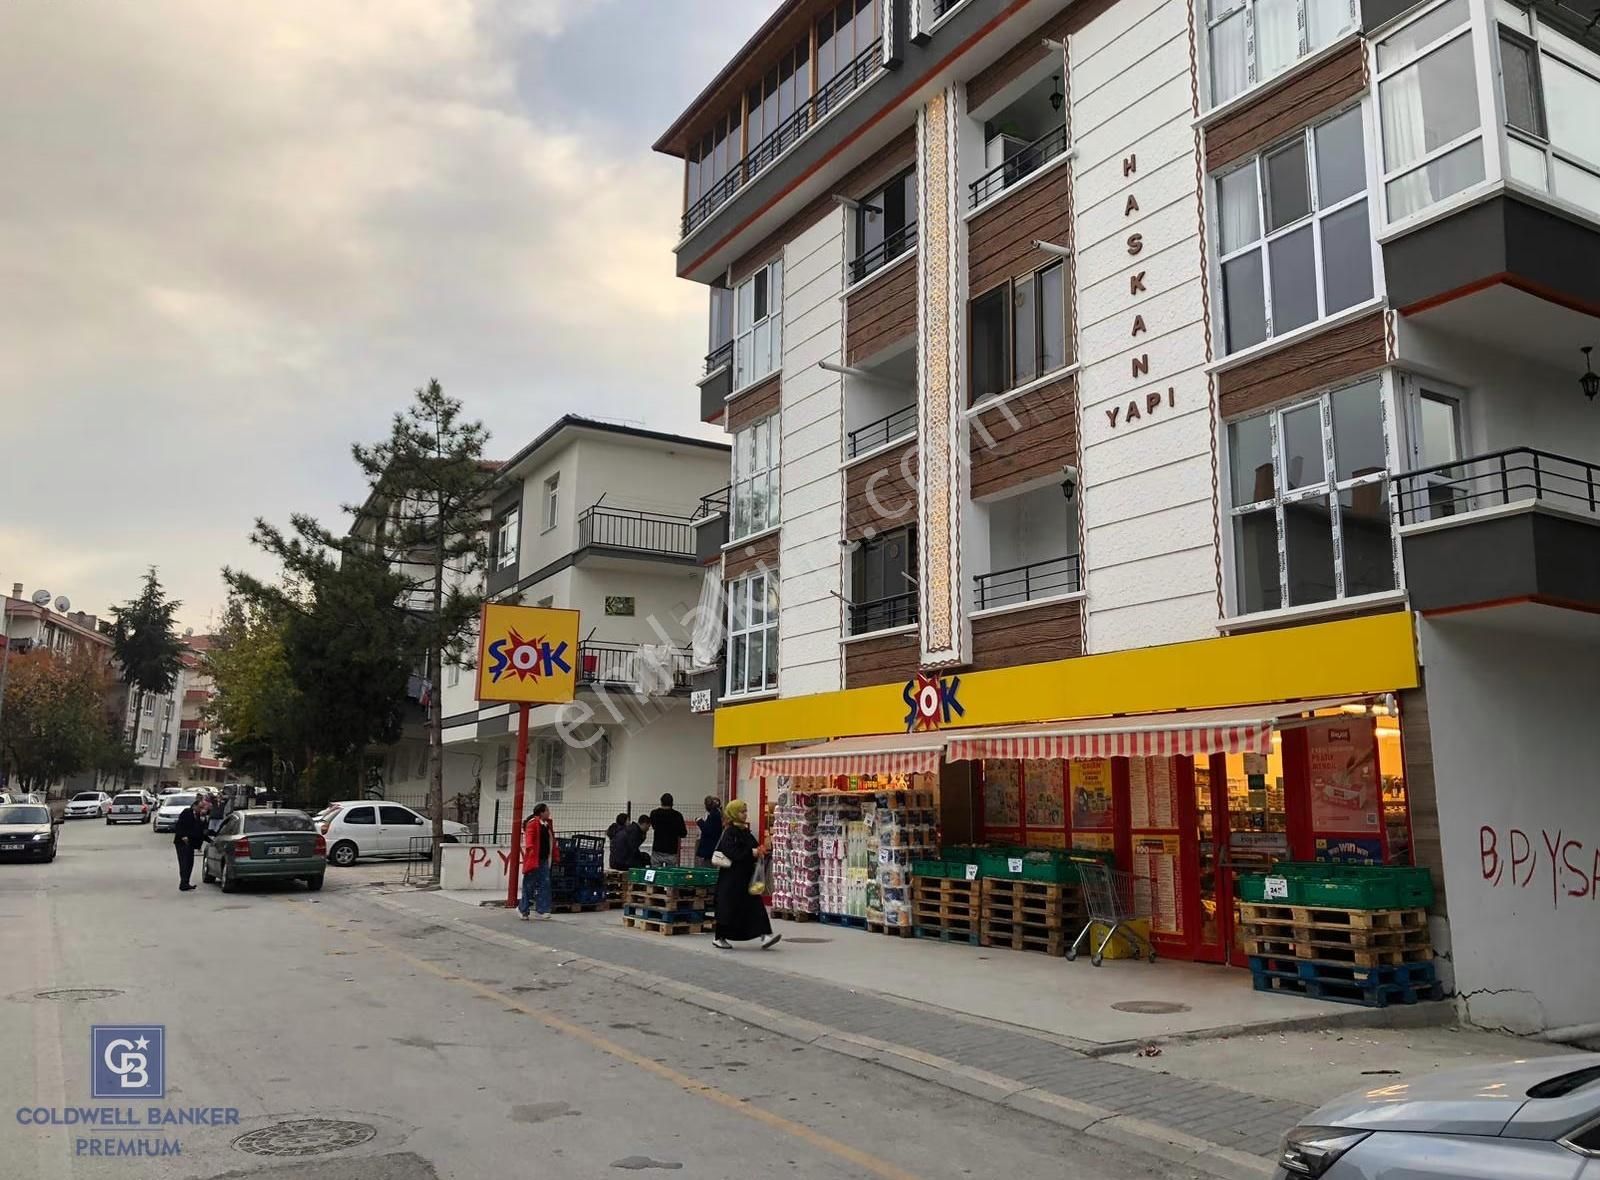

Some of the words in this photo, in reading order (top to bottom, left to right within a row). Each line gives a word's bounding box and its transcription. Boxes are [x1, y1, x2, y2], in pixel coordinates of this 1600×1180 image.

[1123, 153, 1149, 378] HASKAN
[1105, 387, 1175, 428] YAPI
[488, 638, 572, 684] ŞOK
[903, 675, 965, 734] ŞOK
